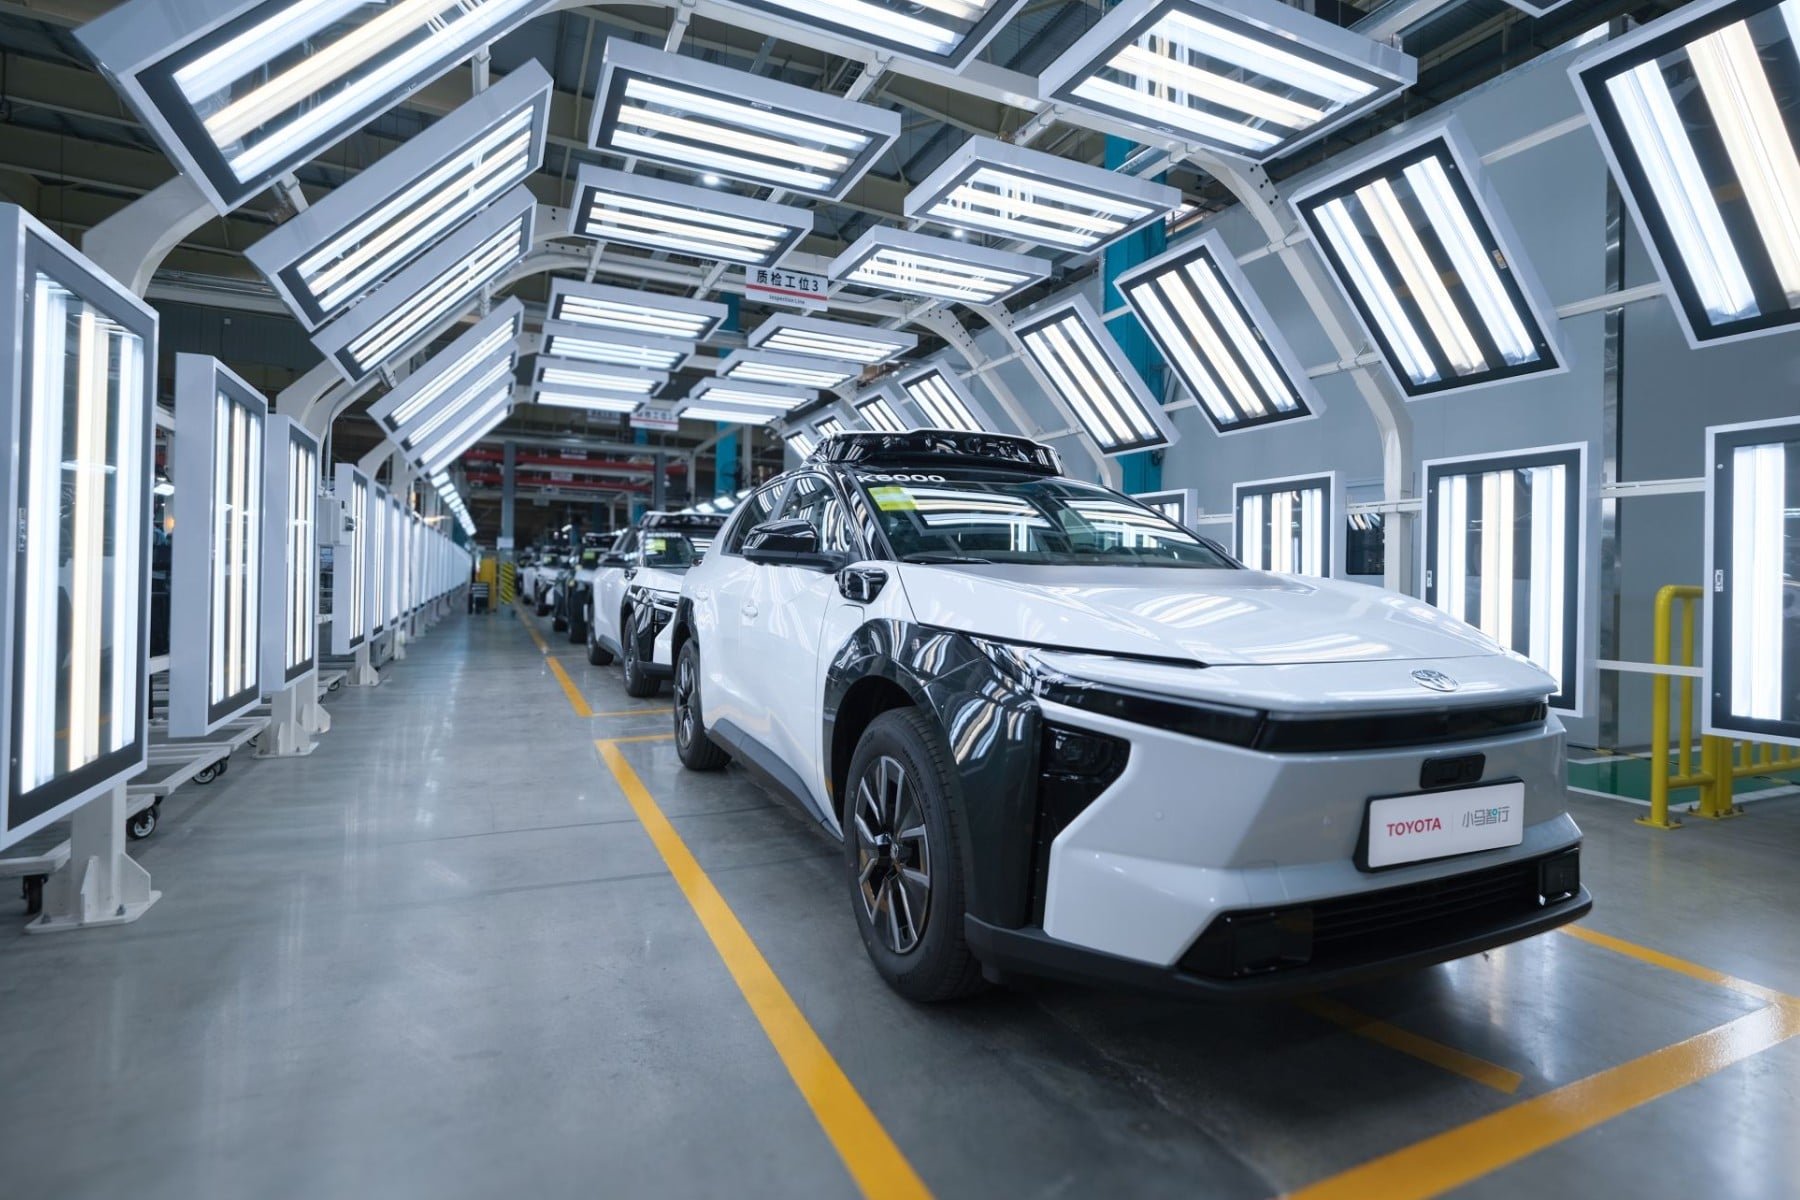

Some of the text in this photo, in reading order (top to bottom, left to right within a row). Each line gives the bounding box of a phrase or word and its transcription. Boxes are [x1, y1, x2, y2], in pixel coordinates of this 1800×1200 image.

[757, 269, 819, 291] 质检工位3
[1387, 817, 1442, 837] TOYOTA
[1462, 806, 1510, 828] 小马智行
